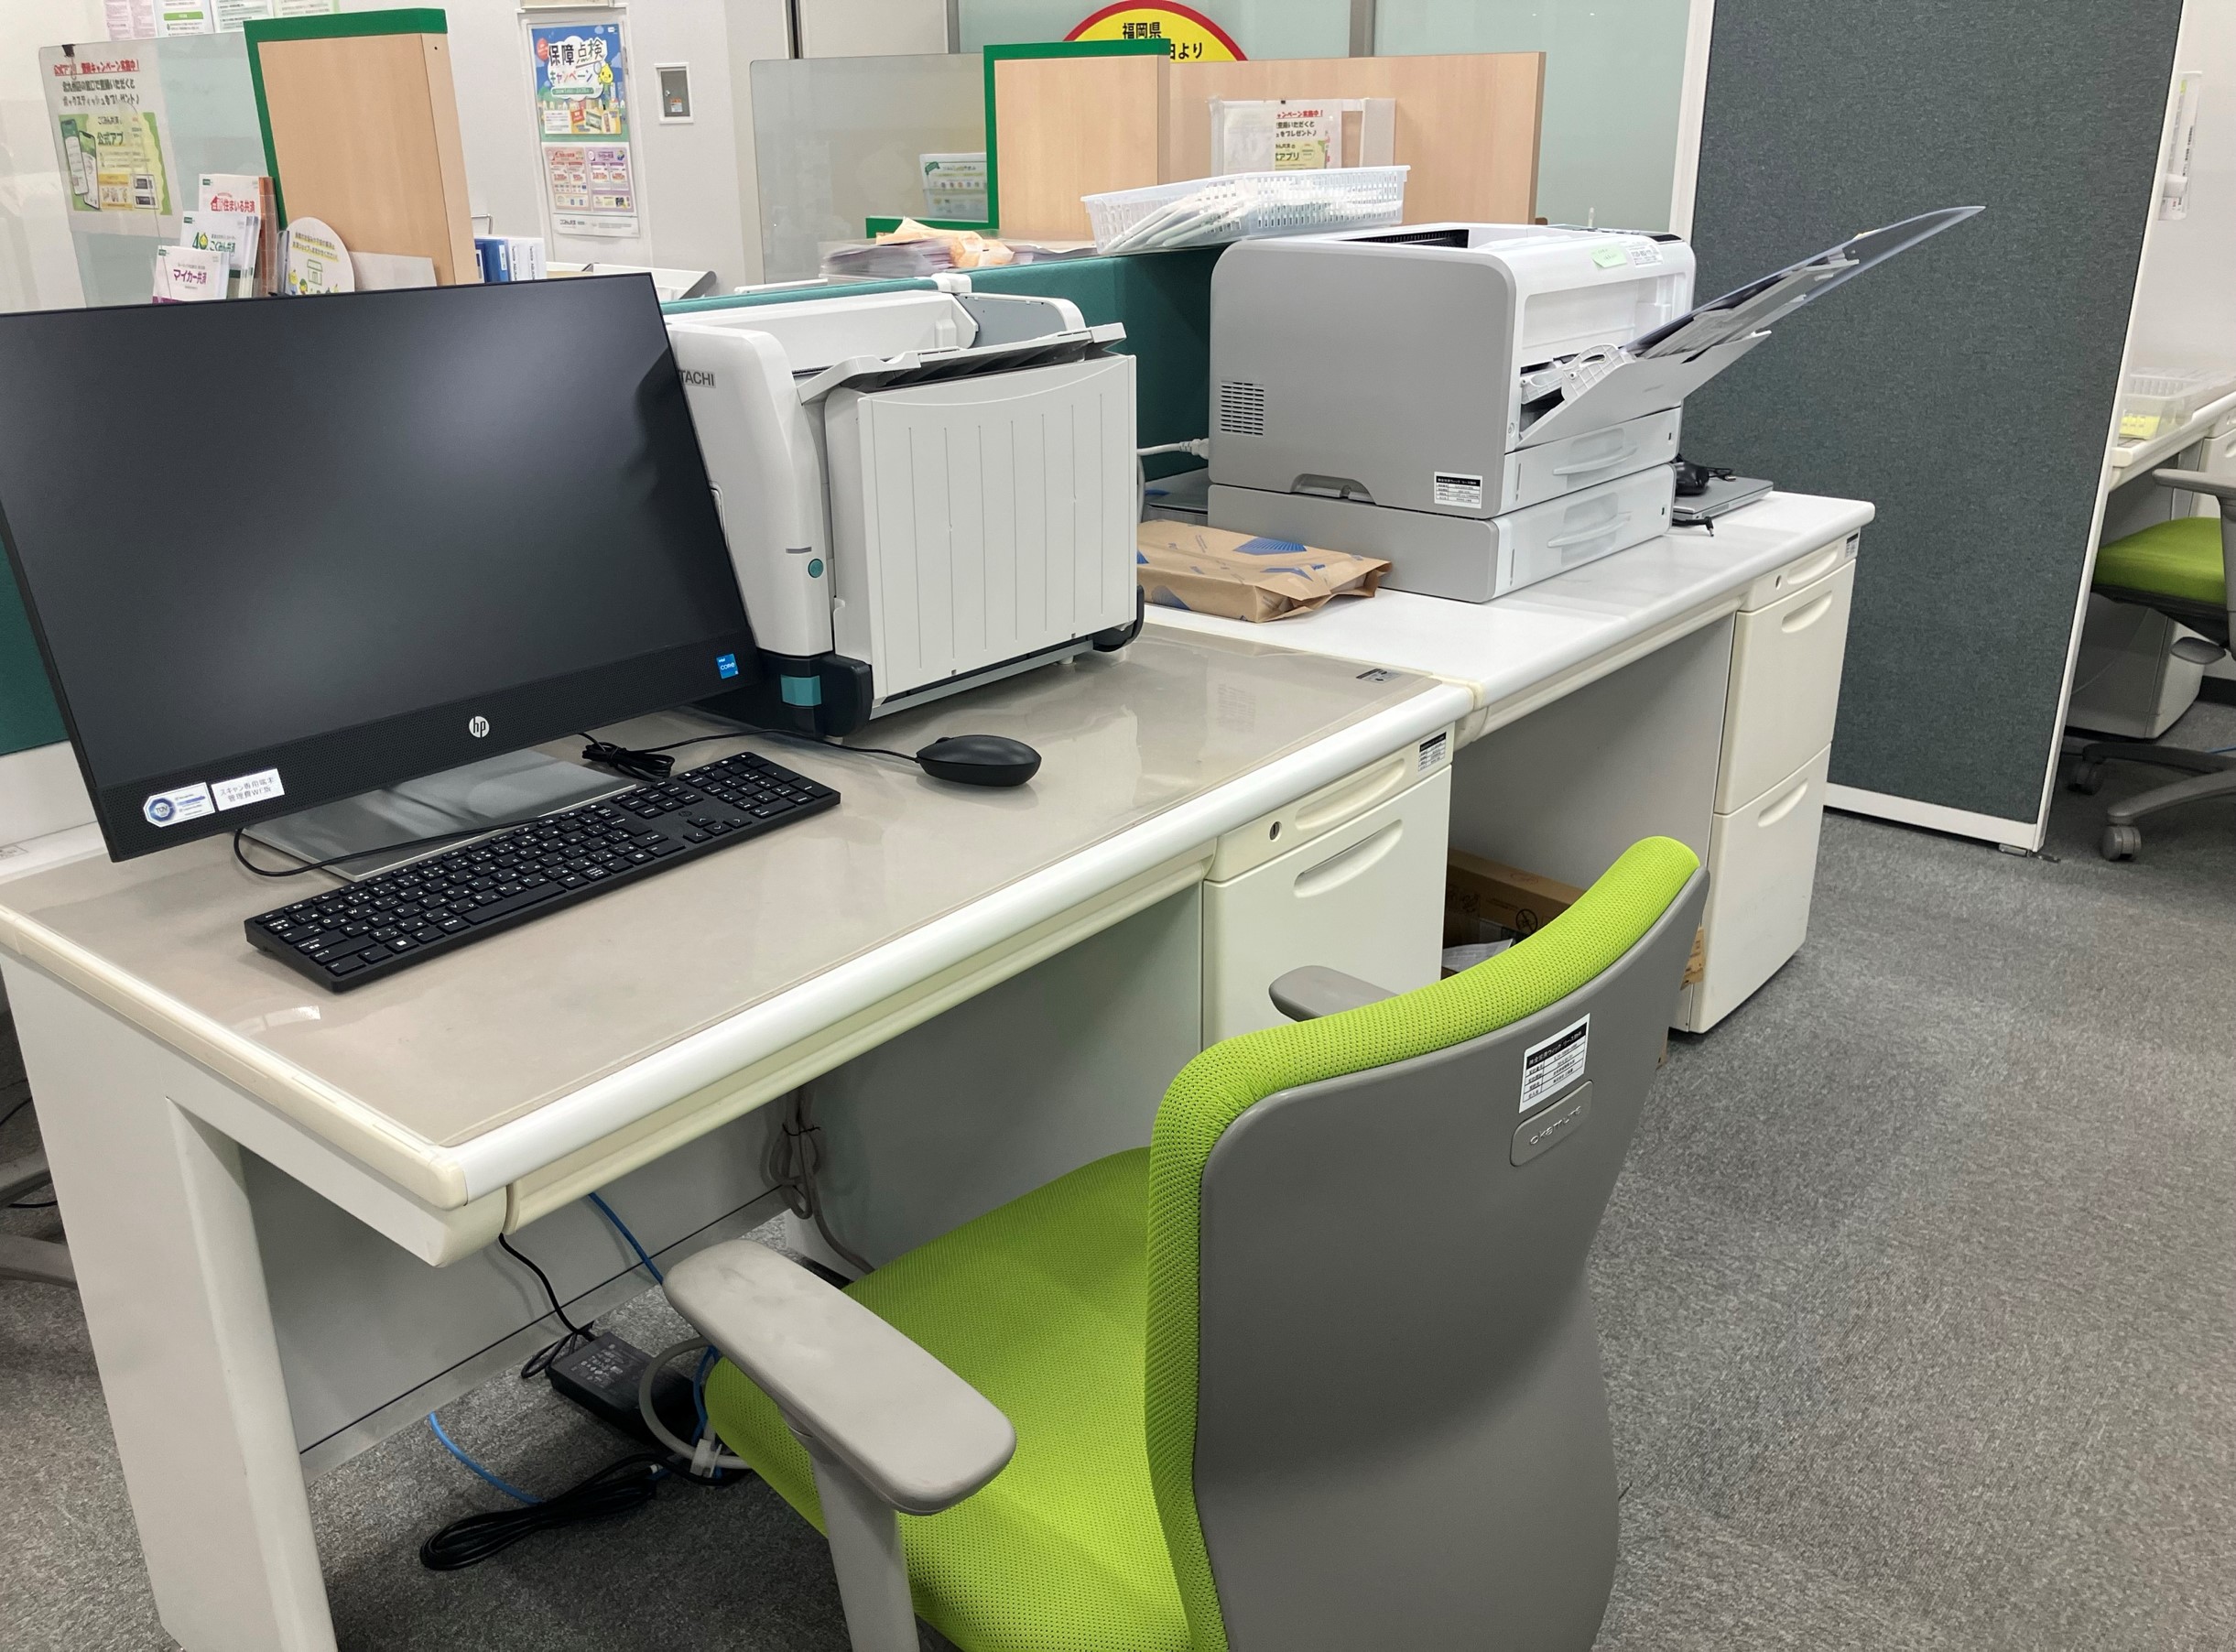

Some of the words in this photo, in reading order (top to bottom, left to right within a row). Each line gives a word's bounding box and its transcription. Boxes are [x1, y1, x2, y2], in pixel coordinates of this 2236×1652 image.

[1123, 22, 1161, 38] 福岡県
[548, 38, 603, 66] 保障点検
[549, 71, 592, 84] キャンペーン
[173, 268, 208, 285] マイカー共済
[472, 716, 487, 737] hp
[1529, 1105, 1581, 1146] okamura
